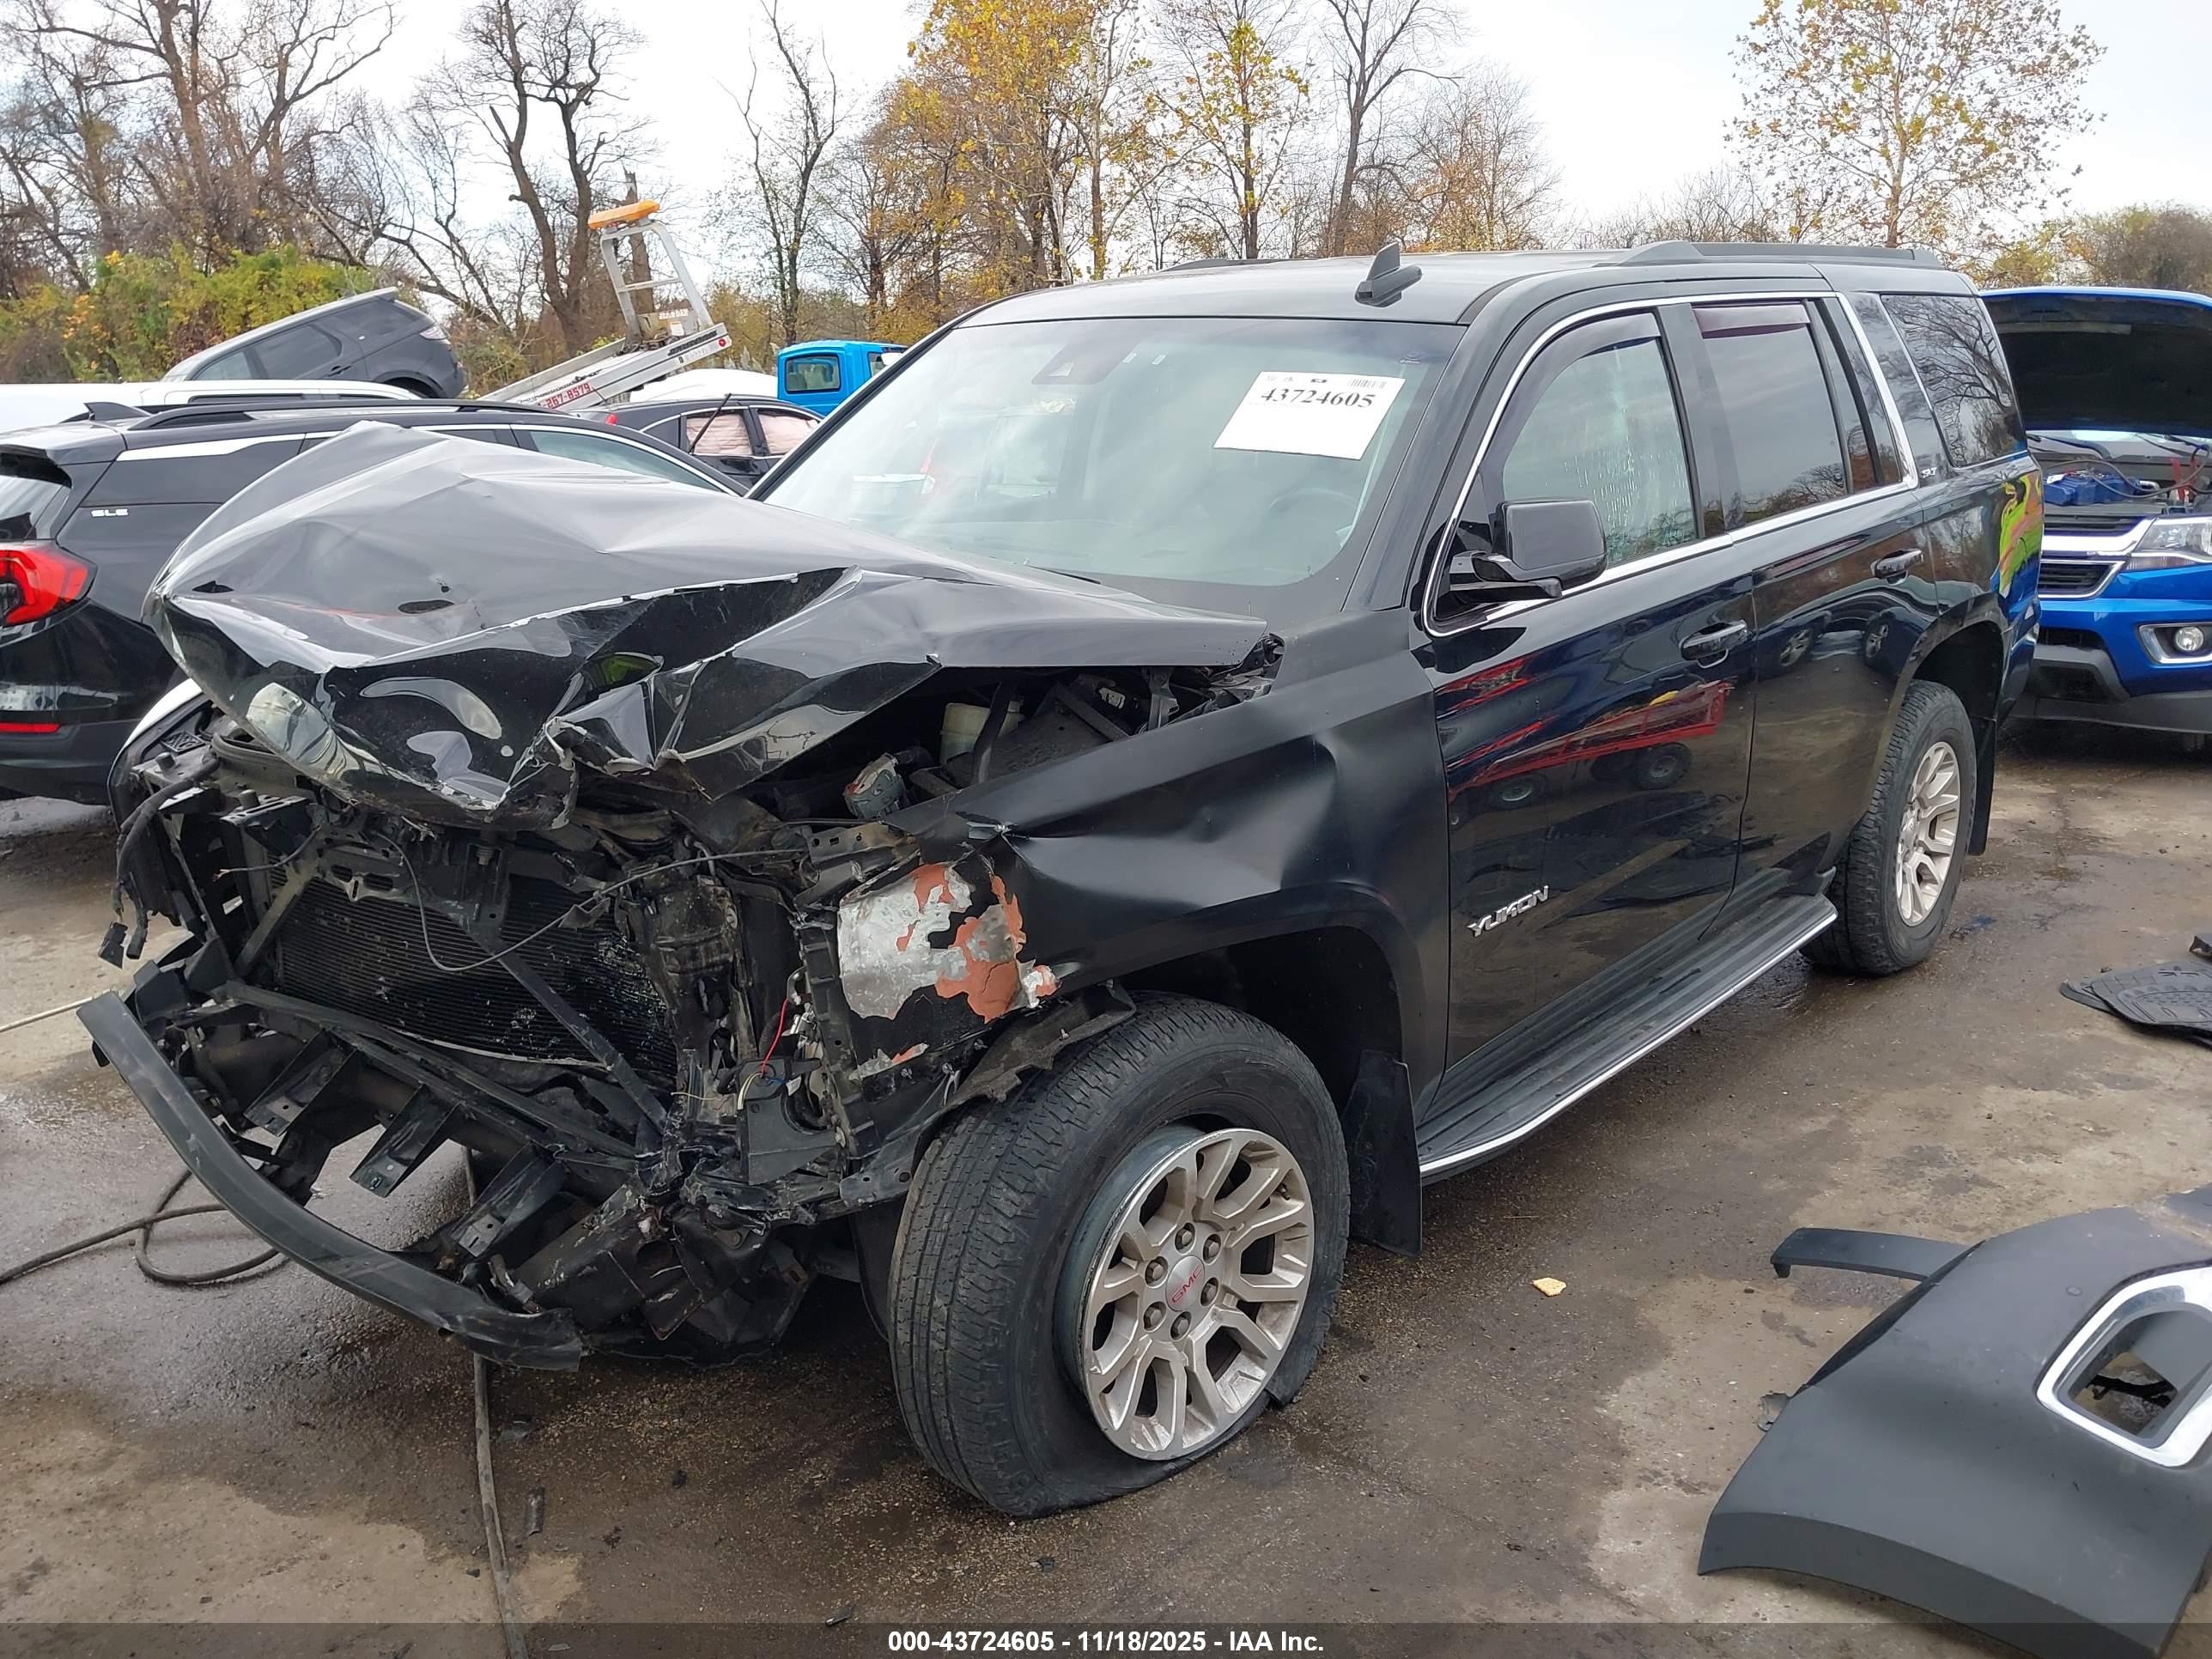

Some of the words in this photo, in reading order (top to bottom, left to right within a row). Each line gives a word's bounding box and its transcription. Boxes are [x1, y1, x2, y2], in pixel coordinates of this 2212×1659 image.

[536, 383, 592, 409] -267-8579
[1261, 387, 1376, 408] 43724605
[91, 508, 129, 517] SLE
[1467, 884, 1549, 938] YUKON
[1171, 1264, 1202, 1304] GMC
